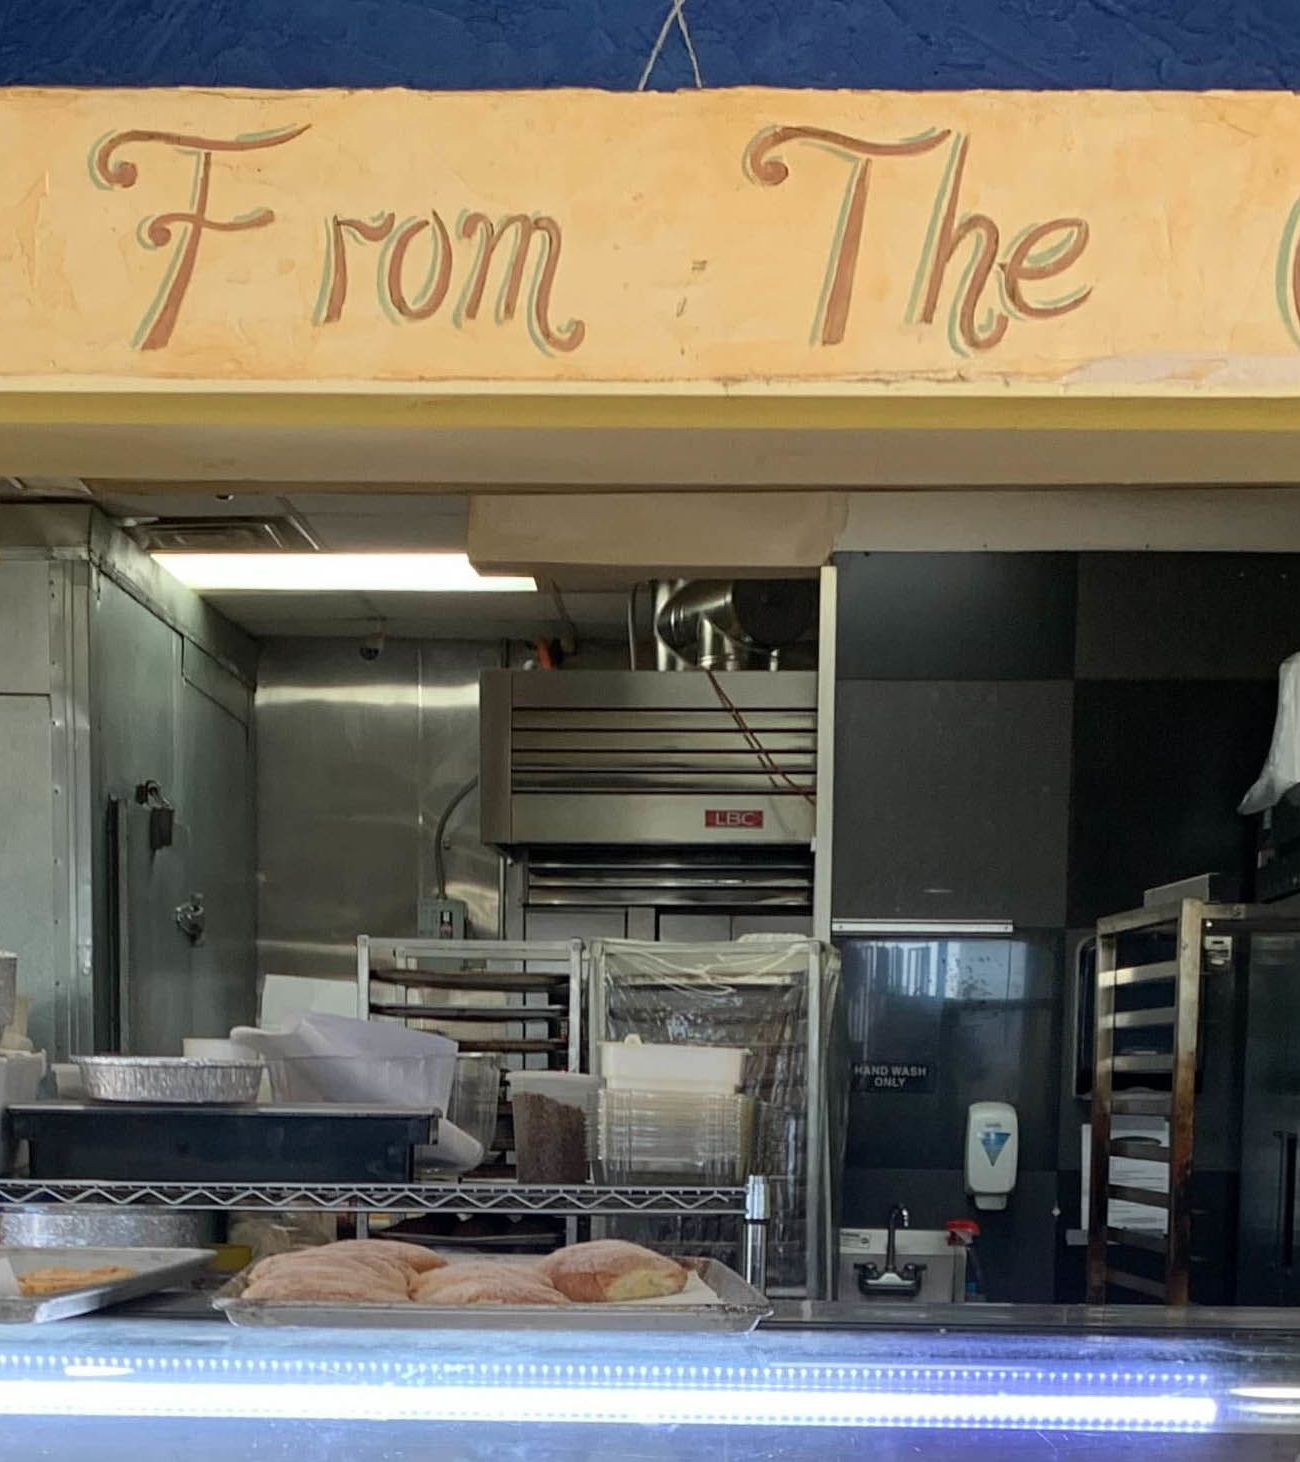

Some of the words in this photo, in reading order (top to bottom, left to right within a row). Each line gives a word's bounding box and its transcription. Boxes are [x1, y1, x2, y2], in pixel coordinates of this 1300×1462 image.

[88, 122, 586, 358] From
[743, 122, 1094, 358] The
[715, 812, 757, 826] LBC
[854, 1065, 889, 1077] HAND
[891, 1065, 927, 1077] WASH
[874, 1076, 906, 1088] ONLY
